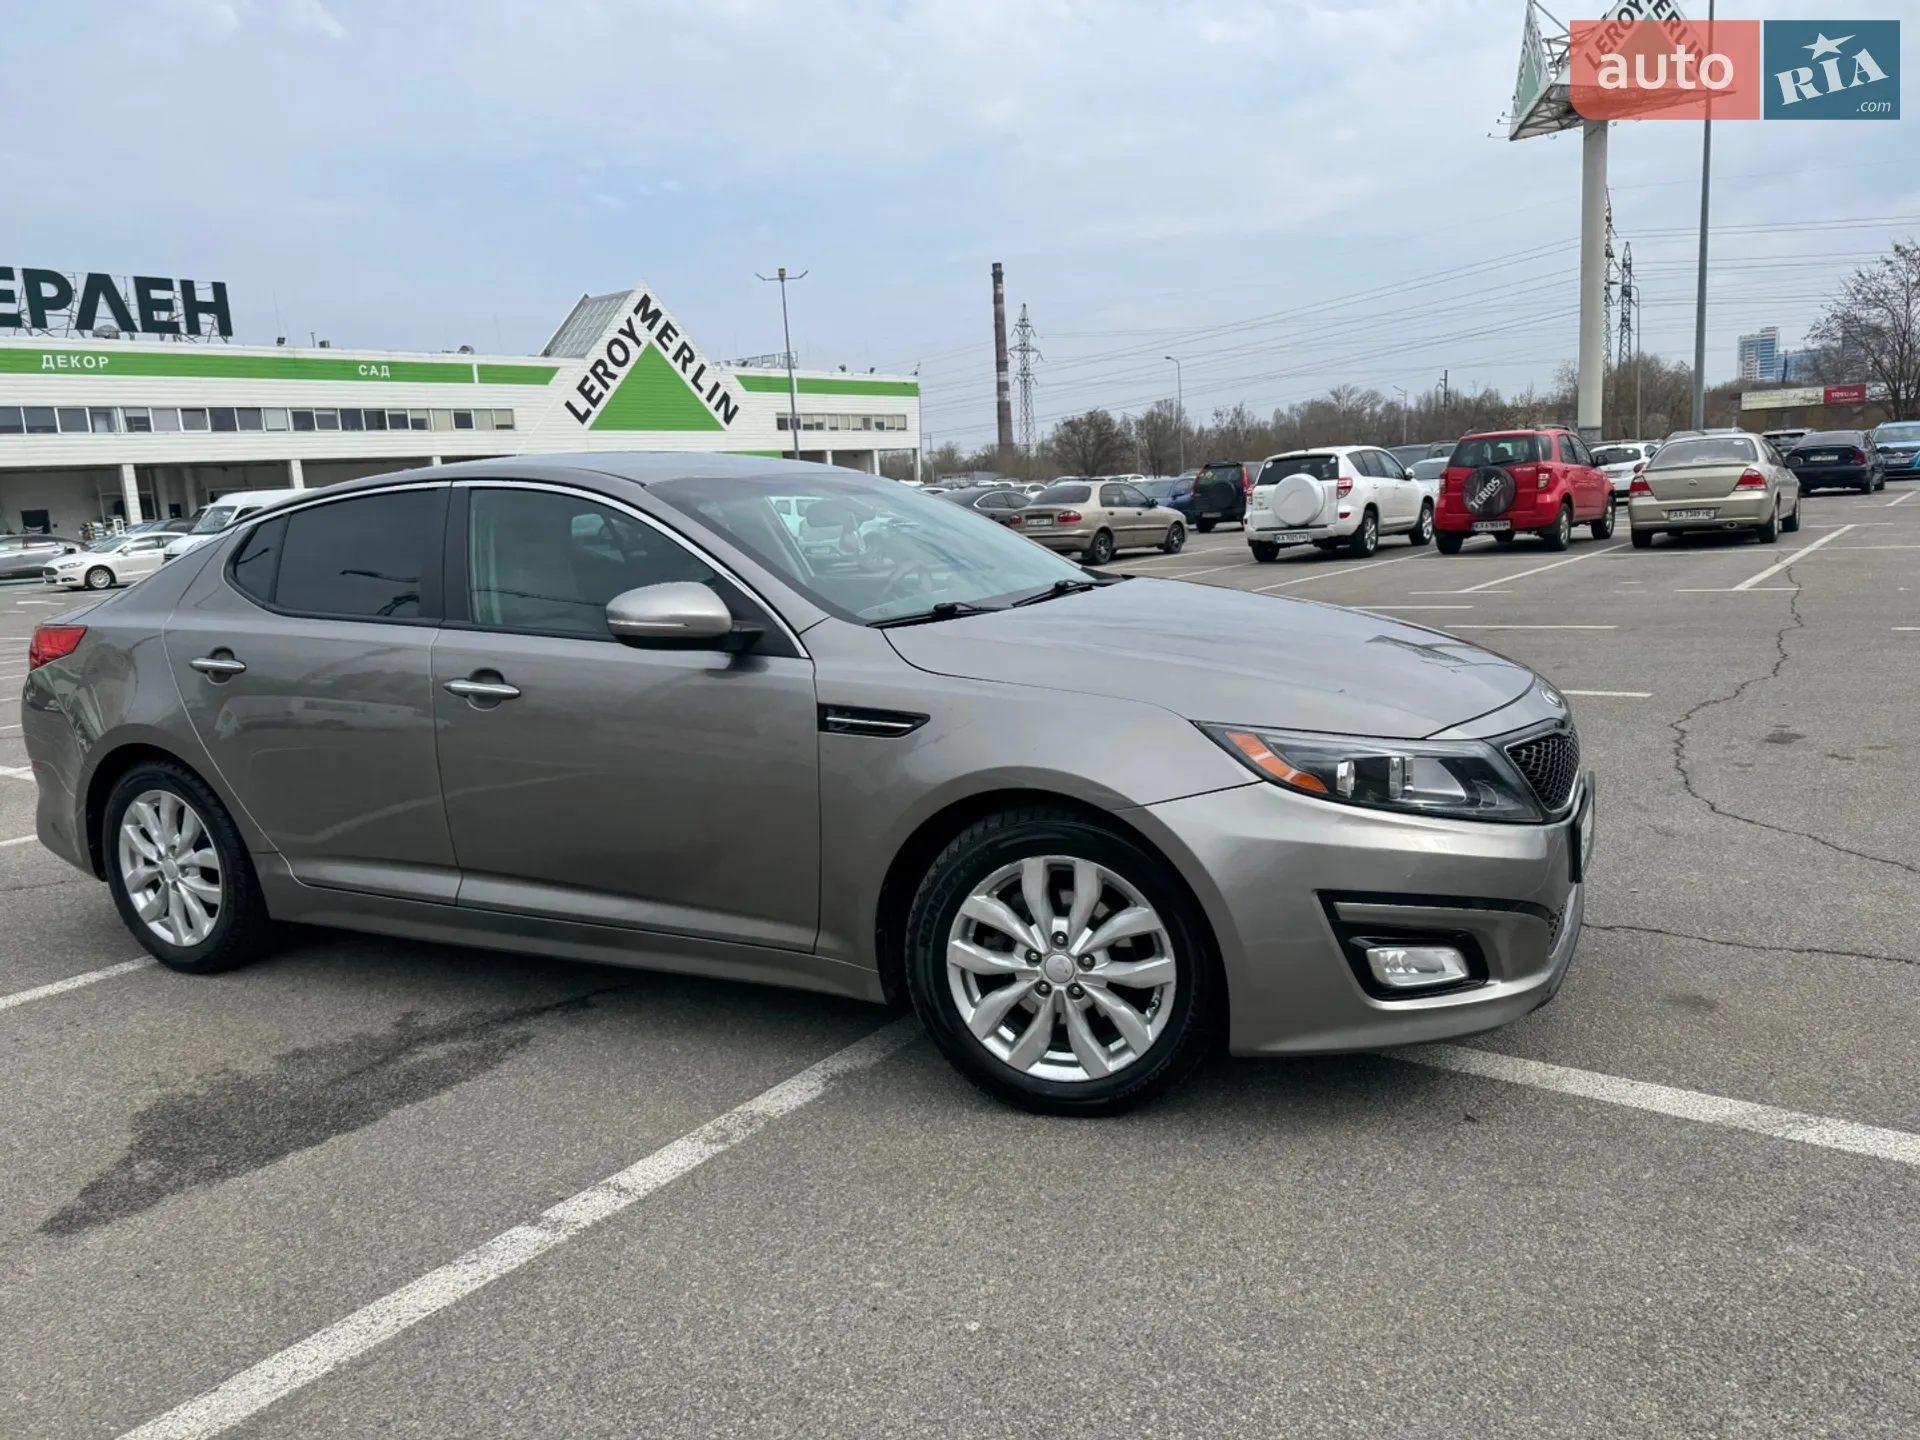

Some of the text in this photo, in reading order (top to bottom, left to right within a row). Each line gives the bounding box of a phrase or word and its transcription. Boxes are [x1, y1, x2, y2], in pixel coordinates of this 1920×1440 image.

[41, 354, 109, 370] ДЕКОР
[358, 364, 391, 378] САД
[564, 293, 740, 426] LEROY MERLIN
[1470, 476, 1501, 509] TERIOS
